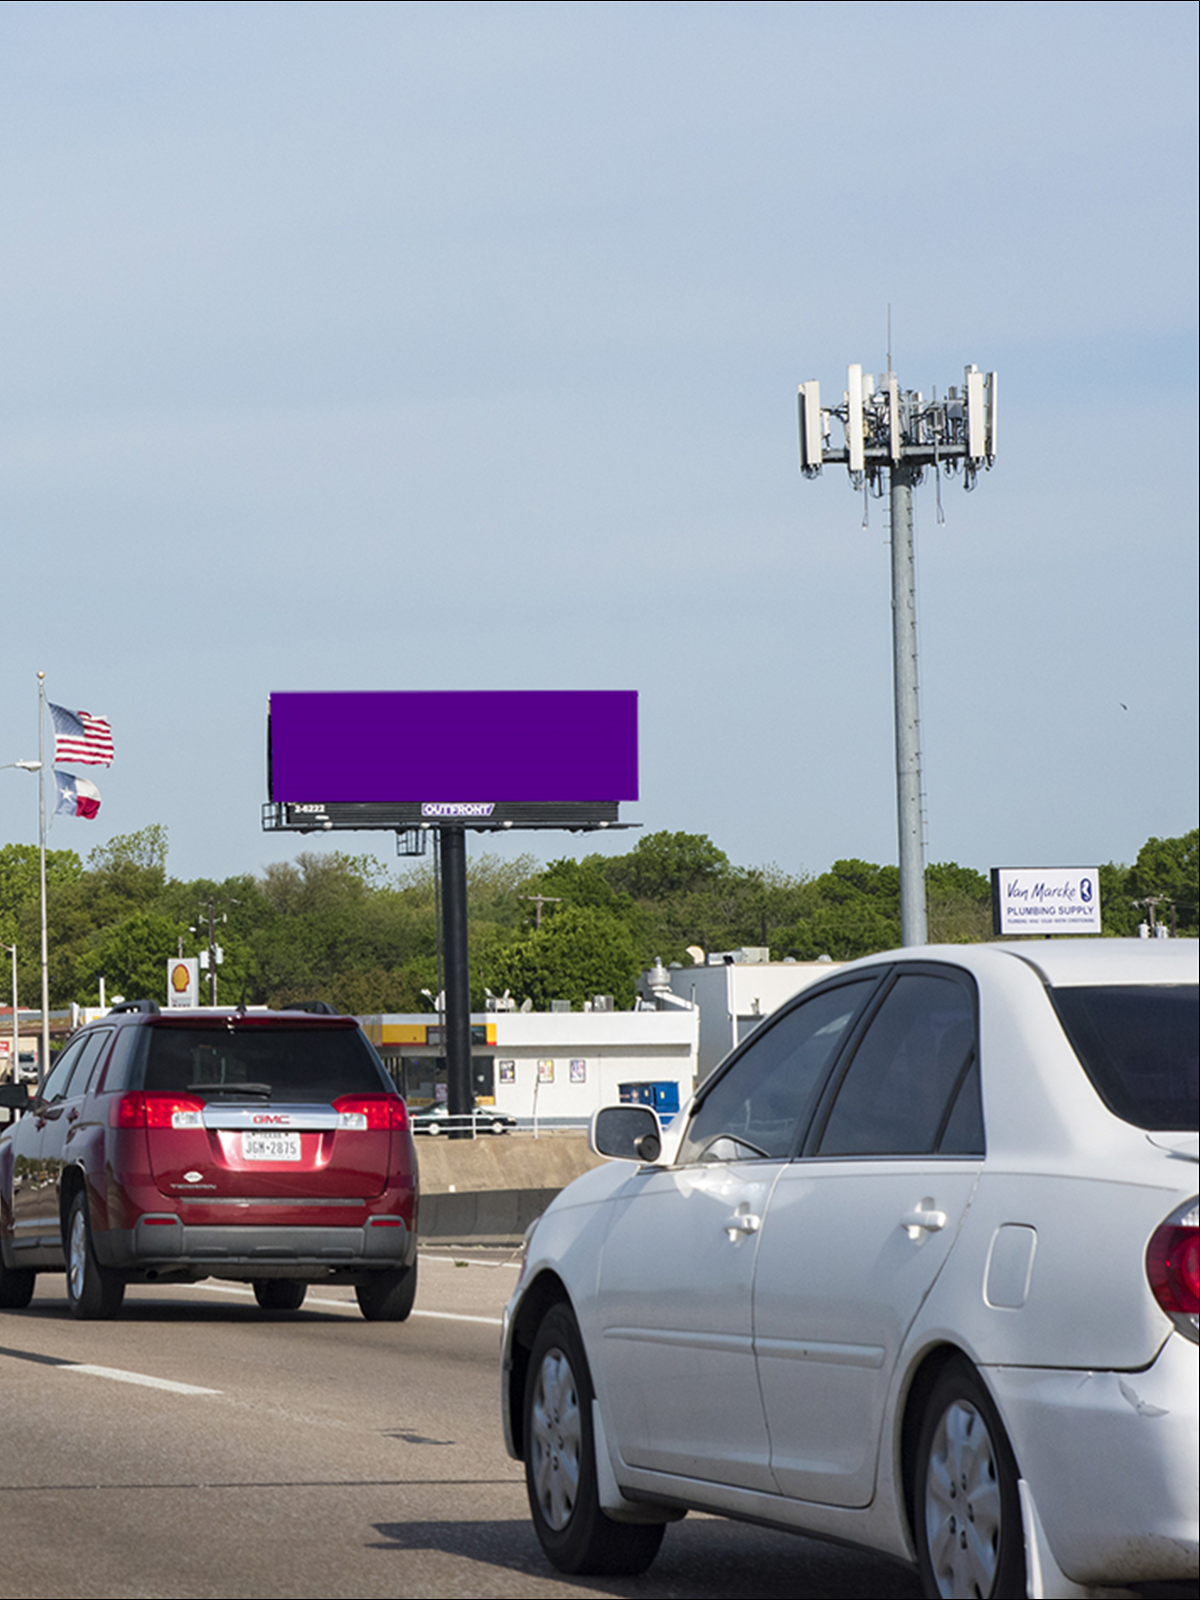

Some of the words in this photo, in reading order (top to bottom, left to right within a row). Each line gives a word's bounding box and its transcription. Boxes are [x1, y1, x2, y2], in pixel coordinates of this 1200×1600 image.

[424, 803, 491, 815] OUTFRONT
[1007, 879, 1028, 901] Van
[1031, 881, 1076, 902] Marcke
[1007, 907, 1056, 916] PLUMBING
[1058, 906, 1094, 916] SUPPLY
[253, 1115, 290, 1124] GMC
